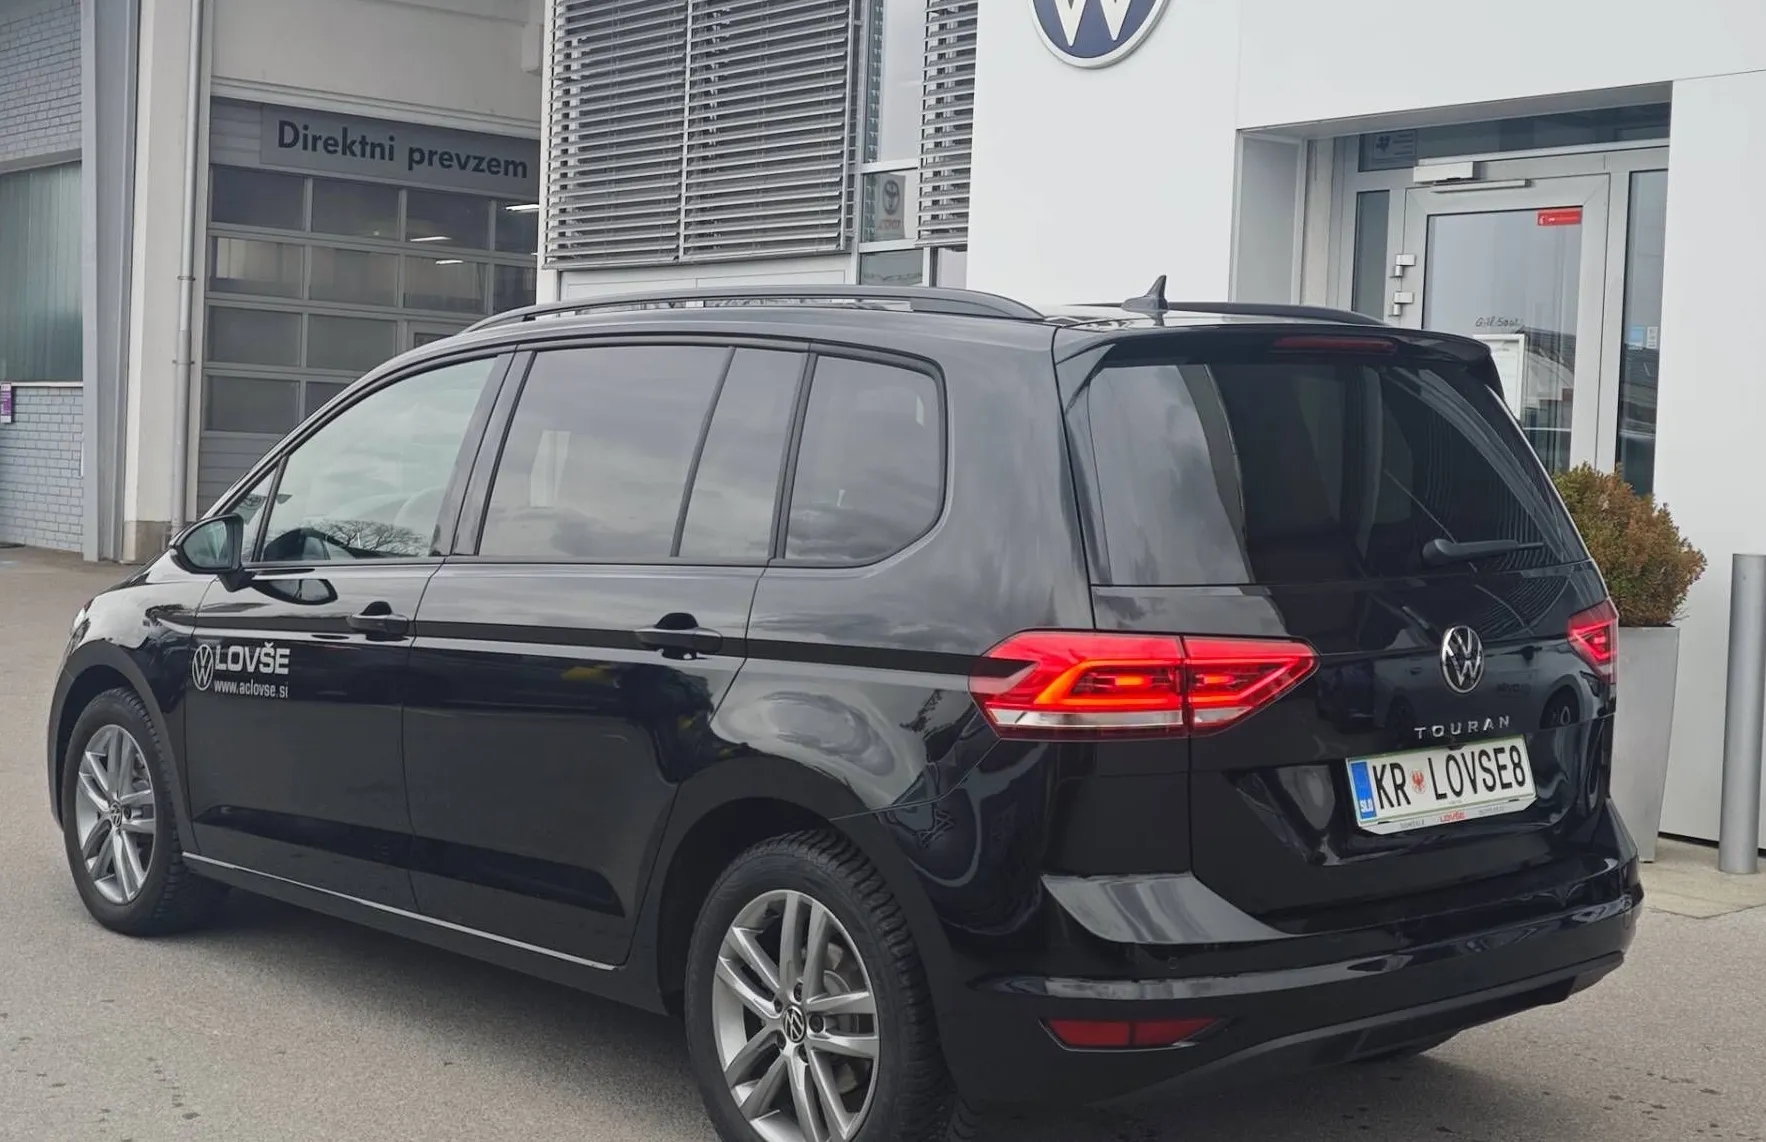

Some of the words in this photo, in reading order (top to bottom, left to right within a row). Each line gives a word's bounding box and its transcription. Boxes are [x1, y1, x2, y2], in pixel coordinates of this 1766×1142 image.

[277, 119, 396, 162] Direktni
[407, 144, 528, 179] prevzem
[214, 641, 291, 675] LOVŠE
[213, 678, 289, 699] www.aclovse.si
[1414, 715, 1510, 740] TOURAN
[1372, 762, 1412, 810] KR
[1427, 744, 1527, 801] LOVSE8
